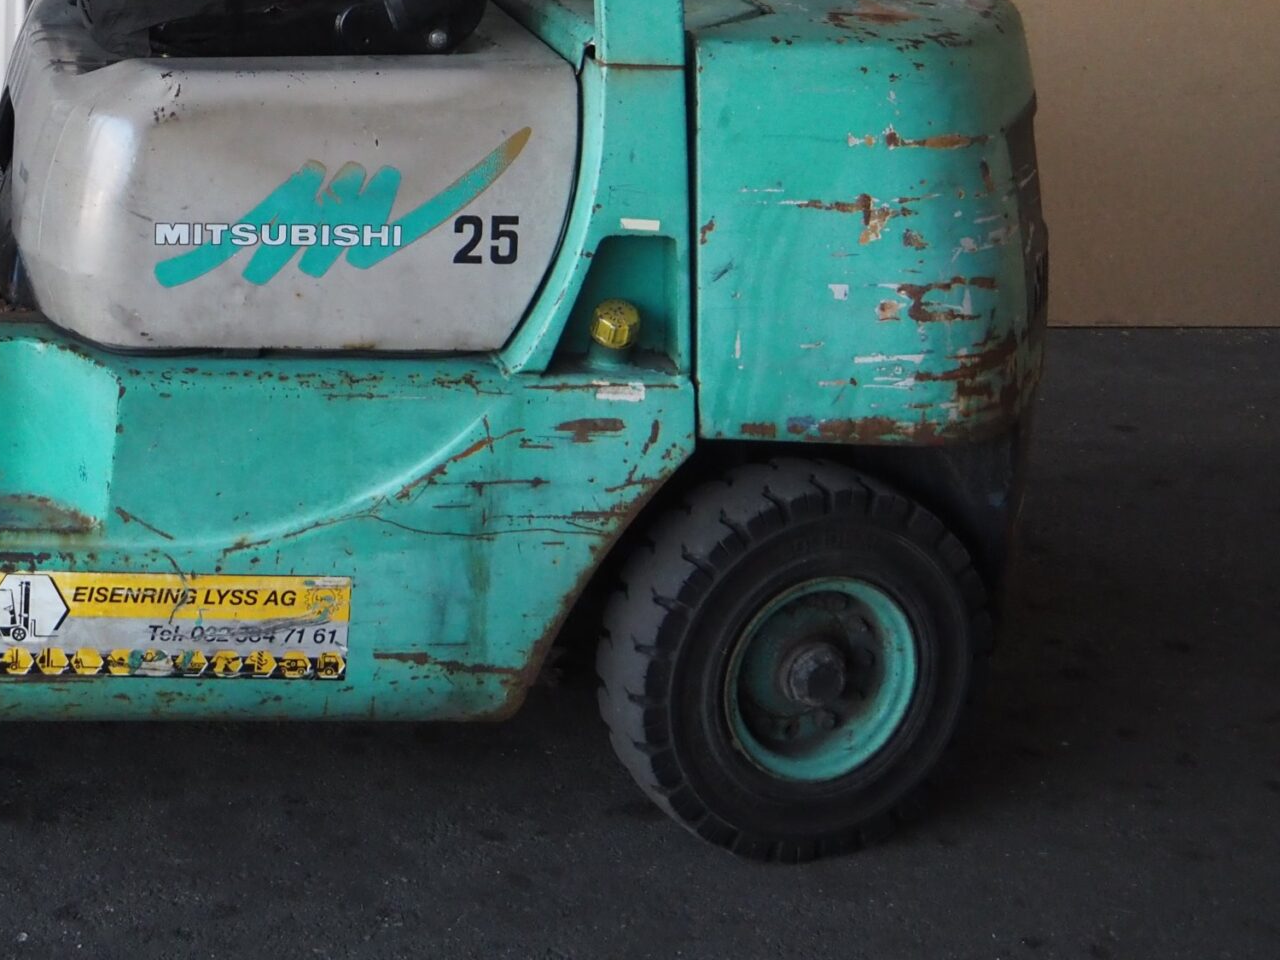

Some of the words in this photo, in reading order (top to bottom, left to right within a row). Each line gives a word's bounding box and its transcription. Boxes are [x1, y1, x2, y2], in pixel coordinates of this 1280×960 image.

[154, 222, 403, 248] MITSUBISHI
[453, 215, 520, 265] 25
[72, 586, 198, 606] EISENRING
[203, 588, 258, 606] LYSS
[263, 590, 297, 607] AG
[284, 628, 306, 644] 71
[313, 628, 338, 645] 61
